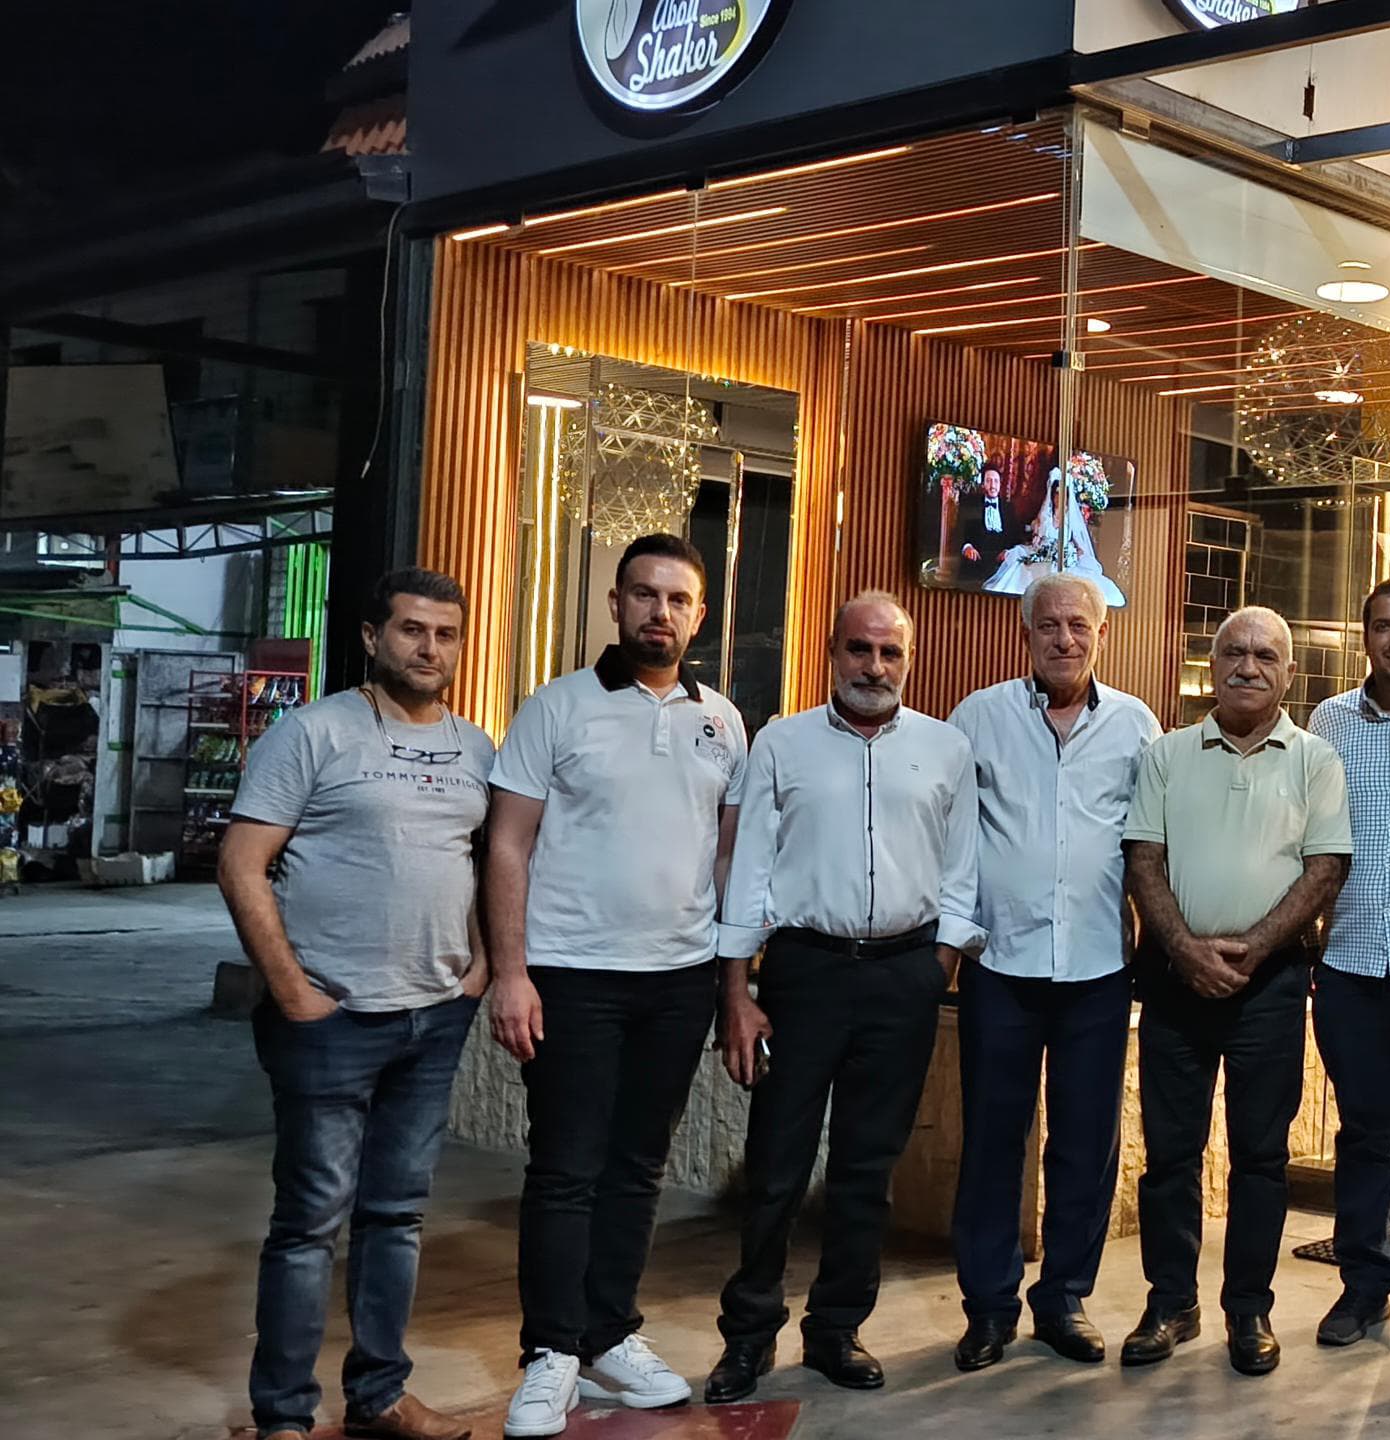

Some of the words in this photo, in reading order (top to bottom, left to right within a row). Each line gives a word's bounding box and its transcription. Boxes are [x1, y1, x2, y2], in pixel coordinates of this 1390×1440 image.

[700, 14, 719, 28] Since
[720, 6, 736, 23] 1994
[629, 24, 720, 91] Shaker
[362, 770, 418, 783] TOMMY
